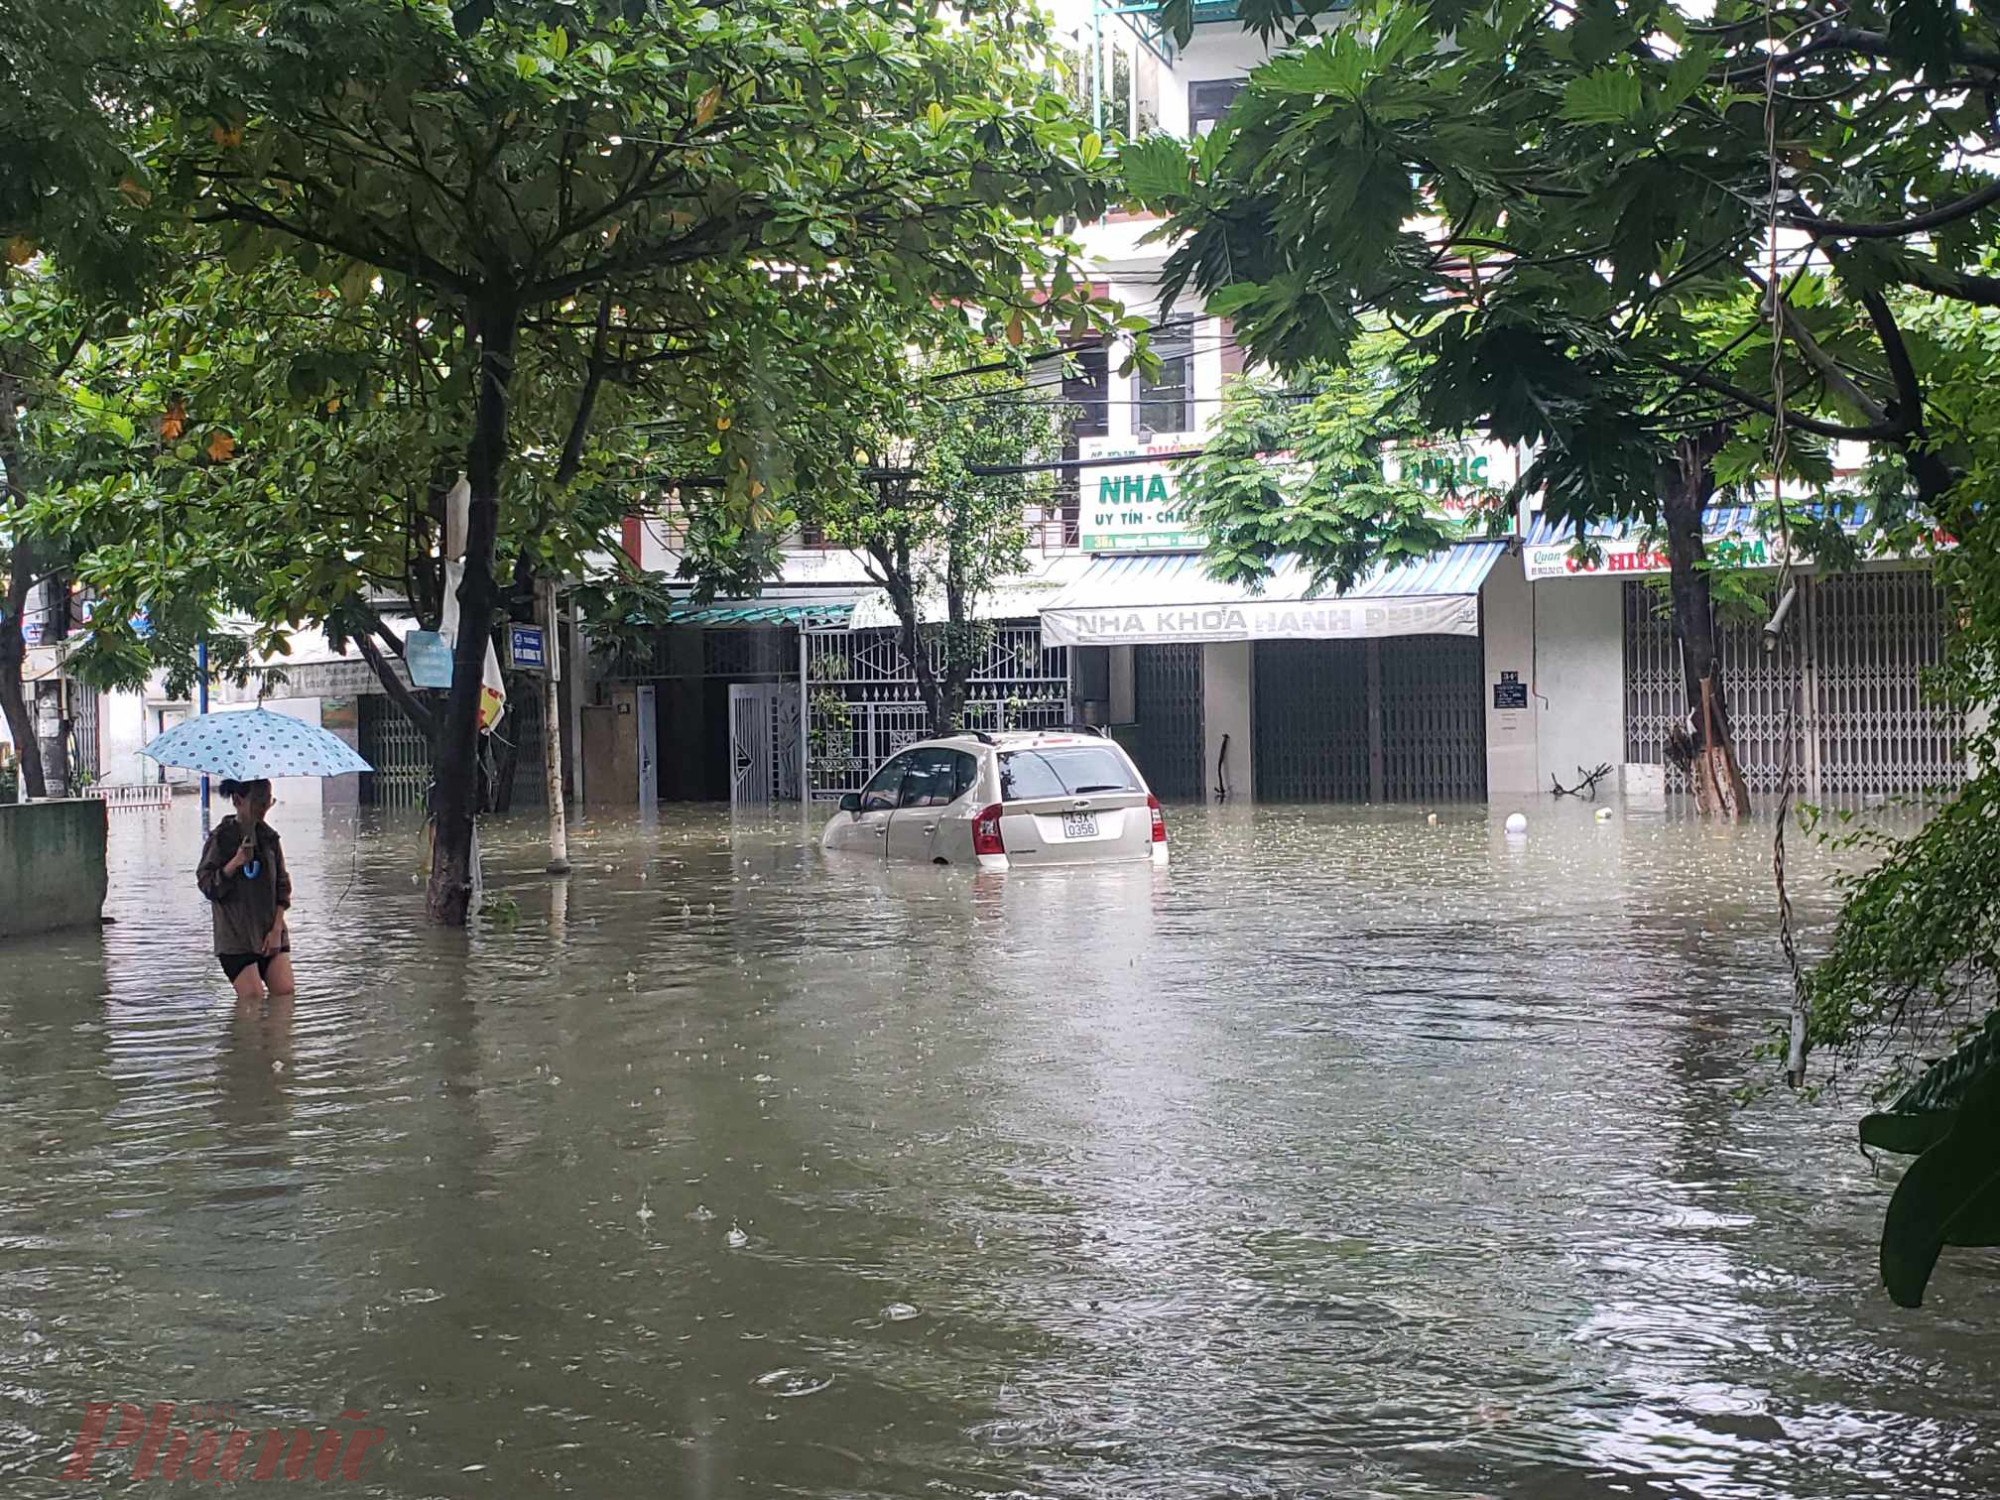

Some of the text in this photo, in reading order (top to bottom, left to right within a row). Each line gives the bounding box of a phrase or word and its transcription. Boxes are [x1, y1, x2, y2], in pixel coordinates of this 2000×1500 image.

[1099, 474, 1167, 504] NHA
[1095, 514, 1114, 525] UY
[1121, 509, 1143, 524] TÍN
[1076, 614, 1145, 634] NHA
[1068, 824, 1095, 836] 0356
